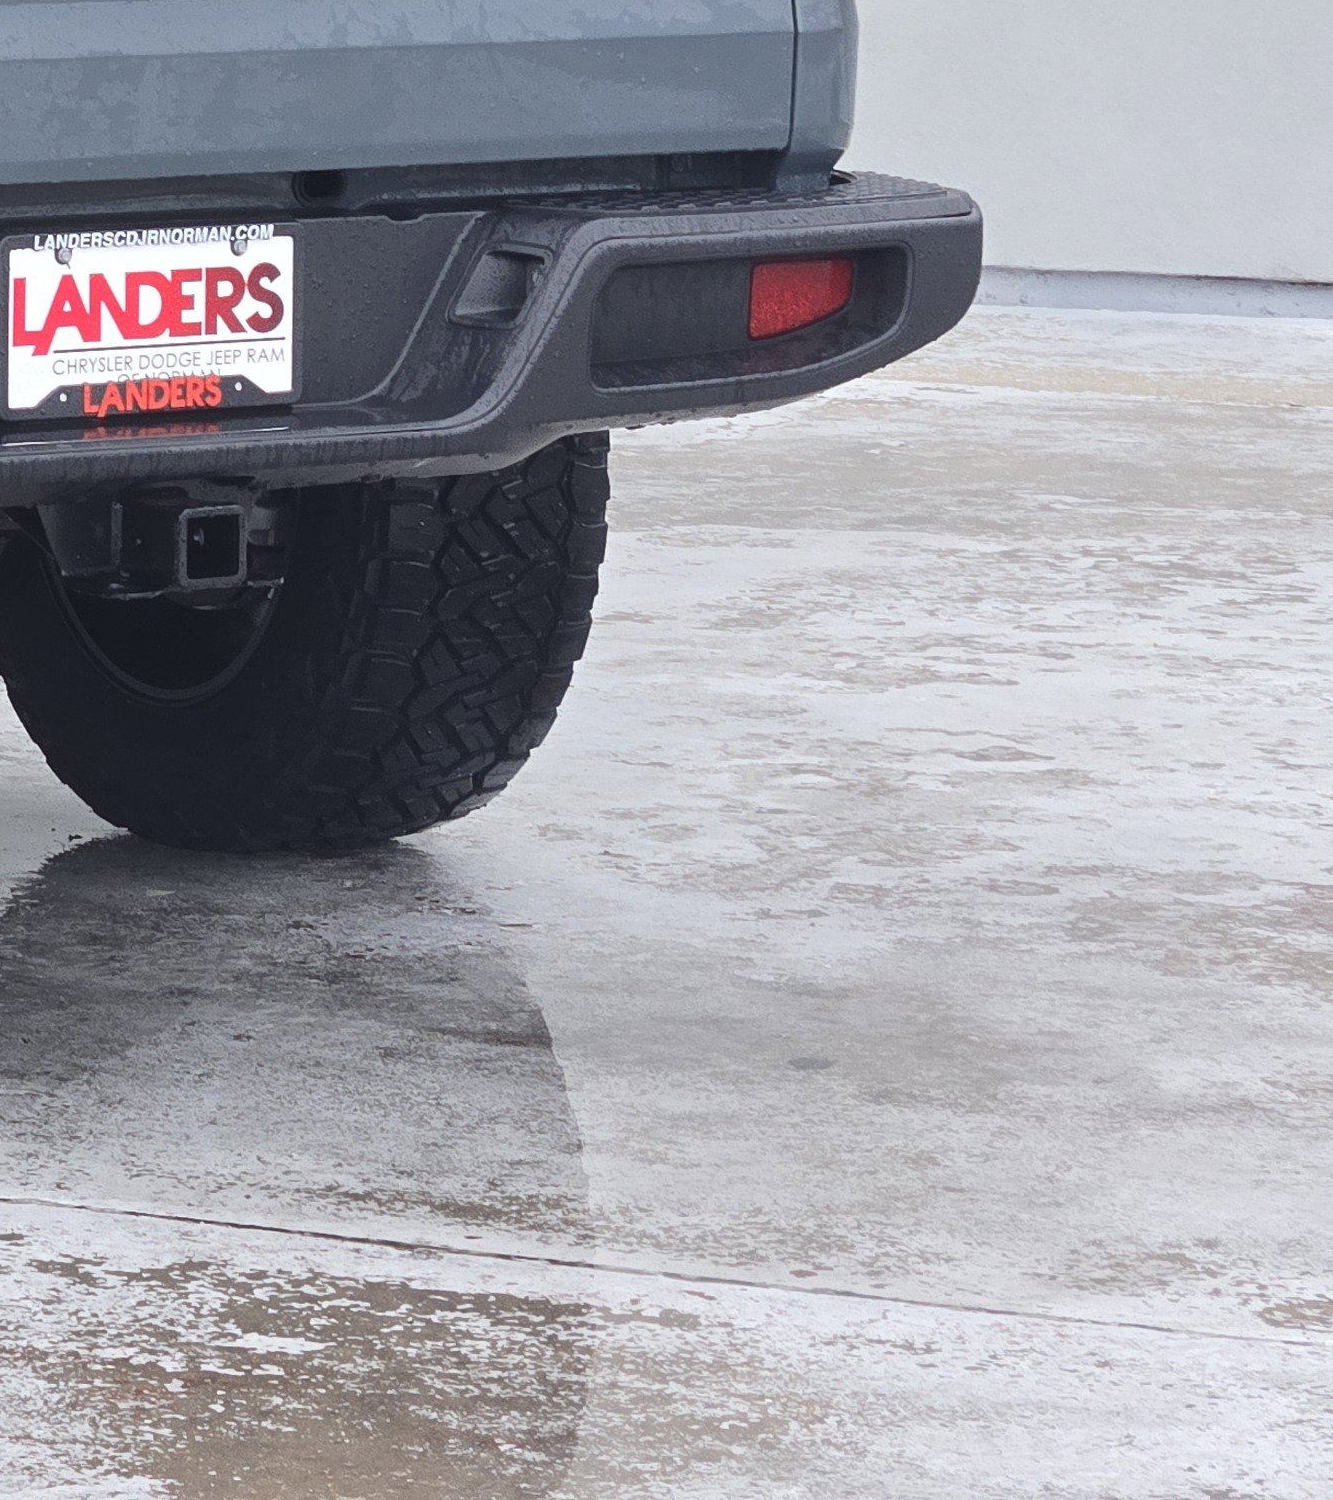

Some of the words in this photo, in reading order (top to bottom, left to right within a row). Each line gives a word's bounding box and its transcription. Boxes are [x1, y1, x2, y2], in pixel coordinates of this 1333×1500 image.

[34, 224, 274, 250] LANDERSCDJRNORMAN.COM
[12, 262, 284, 356] LANDERS
[52, 356, 133, 375] CHRYSLER
[138, 352, 201, 370] DODGE
[206, 350, 242, 366] JEEP
[247, 348, 285, 363] RAM
[84, 374, 222, 418] LANDERS
